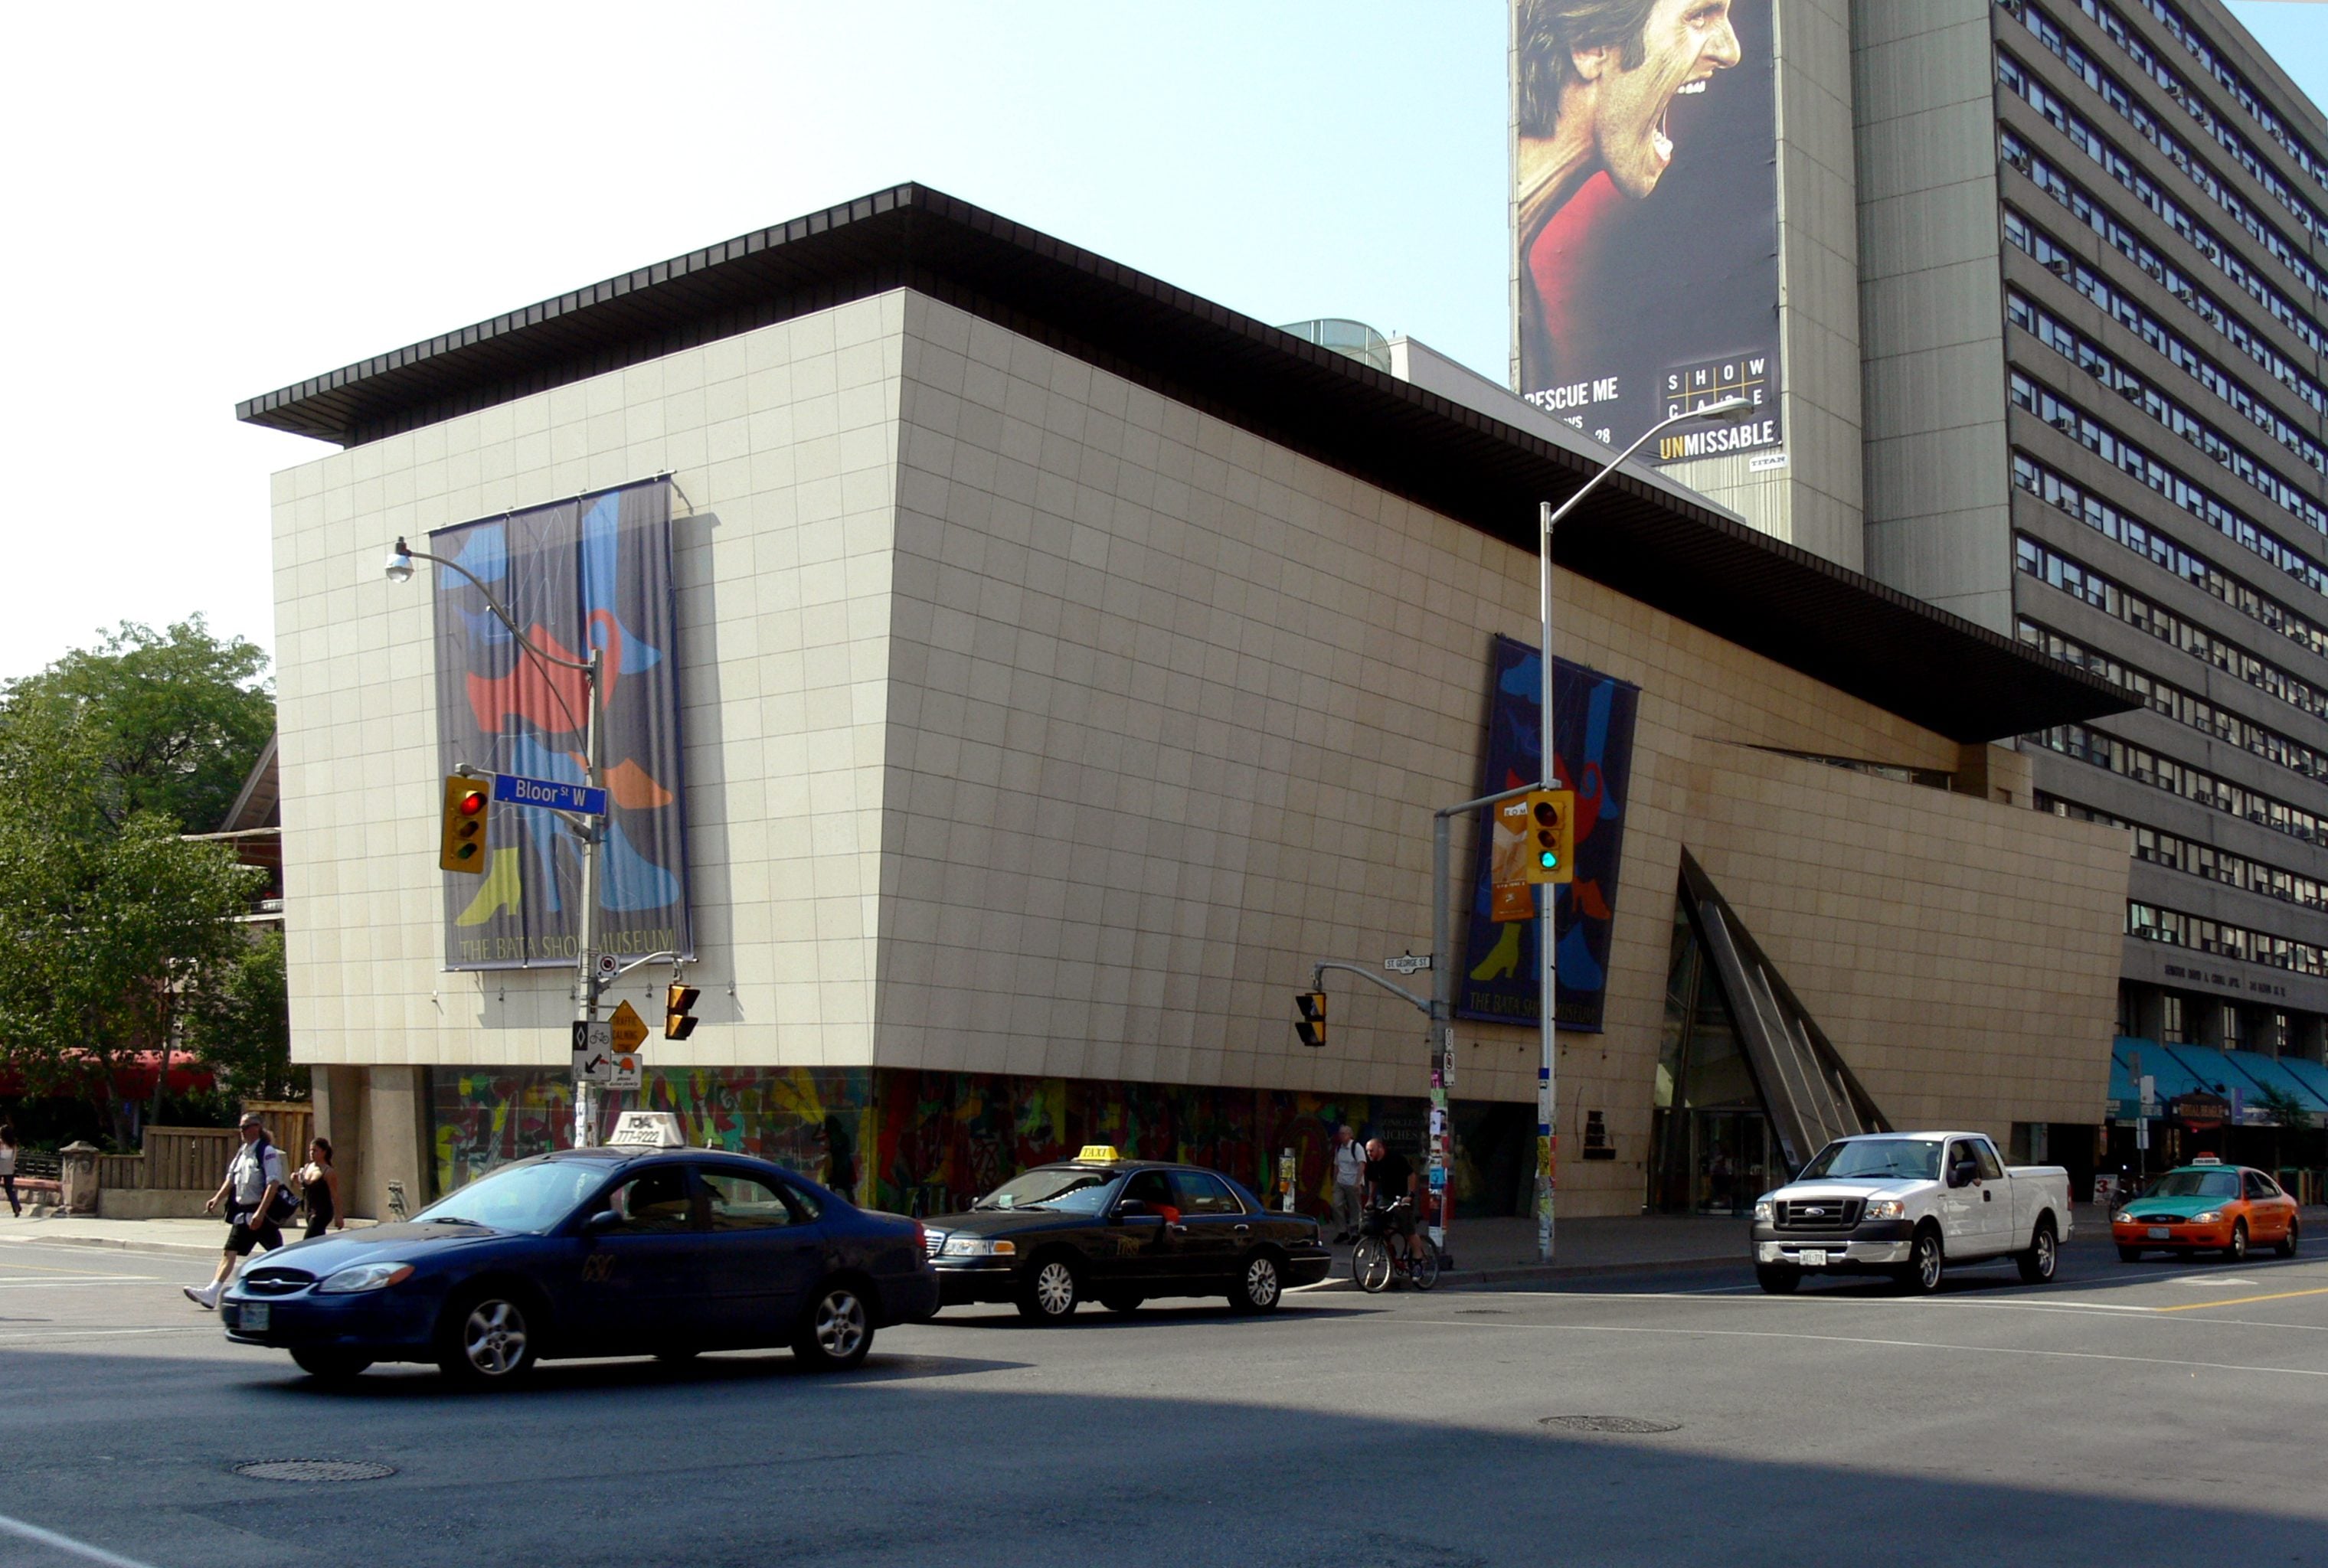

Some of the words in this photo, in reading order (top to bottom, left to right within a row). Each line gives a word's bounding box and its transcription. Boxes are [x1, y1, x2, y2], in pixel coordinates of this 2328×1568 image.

[1593, 376, 1619, 403] ME
[1659, 420, 1774, 460] UNMISSABLE
[1751, 454, 1787, 469] TITAN
[515, 779, 558, 802] Bloor
[561, 786, 569, 797] St
[573, 788, 586, 807] W
[459, 939, 490, 962] THE
[497, 936, 536, 959] BATA
[542, 936, 580, 958] SHO
[597, 929, 675, 955] MUSEUM
[1396, 958, 1418, 968] GEORGE
[1470, 991, 1491, 1012] THE
[1494, 993, 1519, 1014] BATA
[617, 1130, 660, 1143] 777-9222
[1083, 1148, 1107, 1158] TAXI
